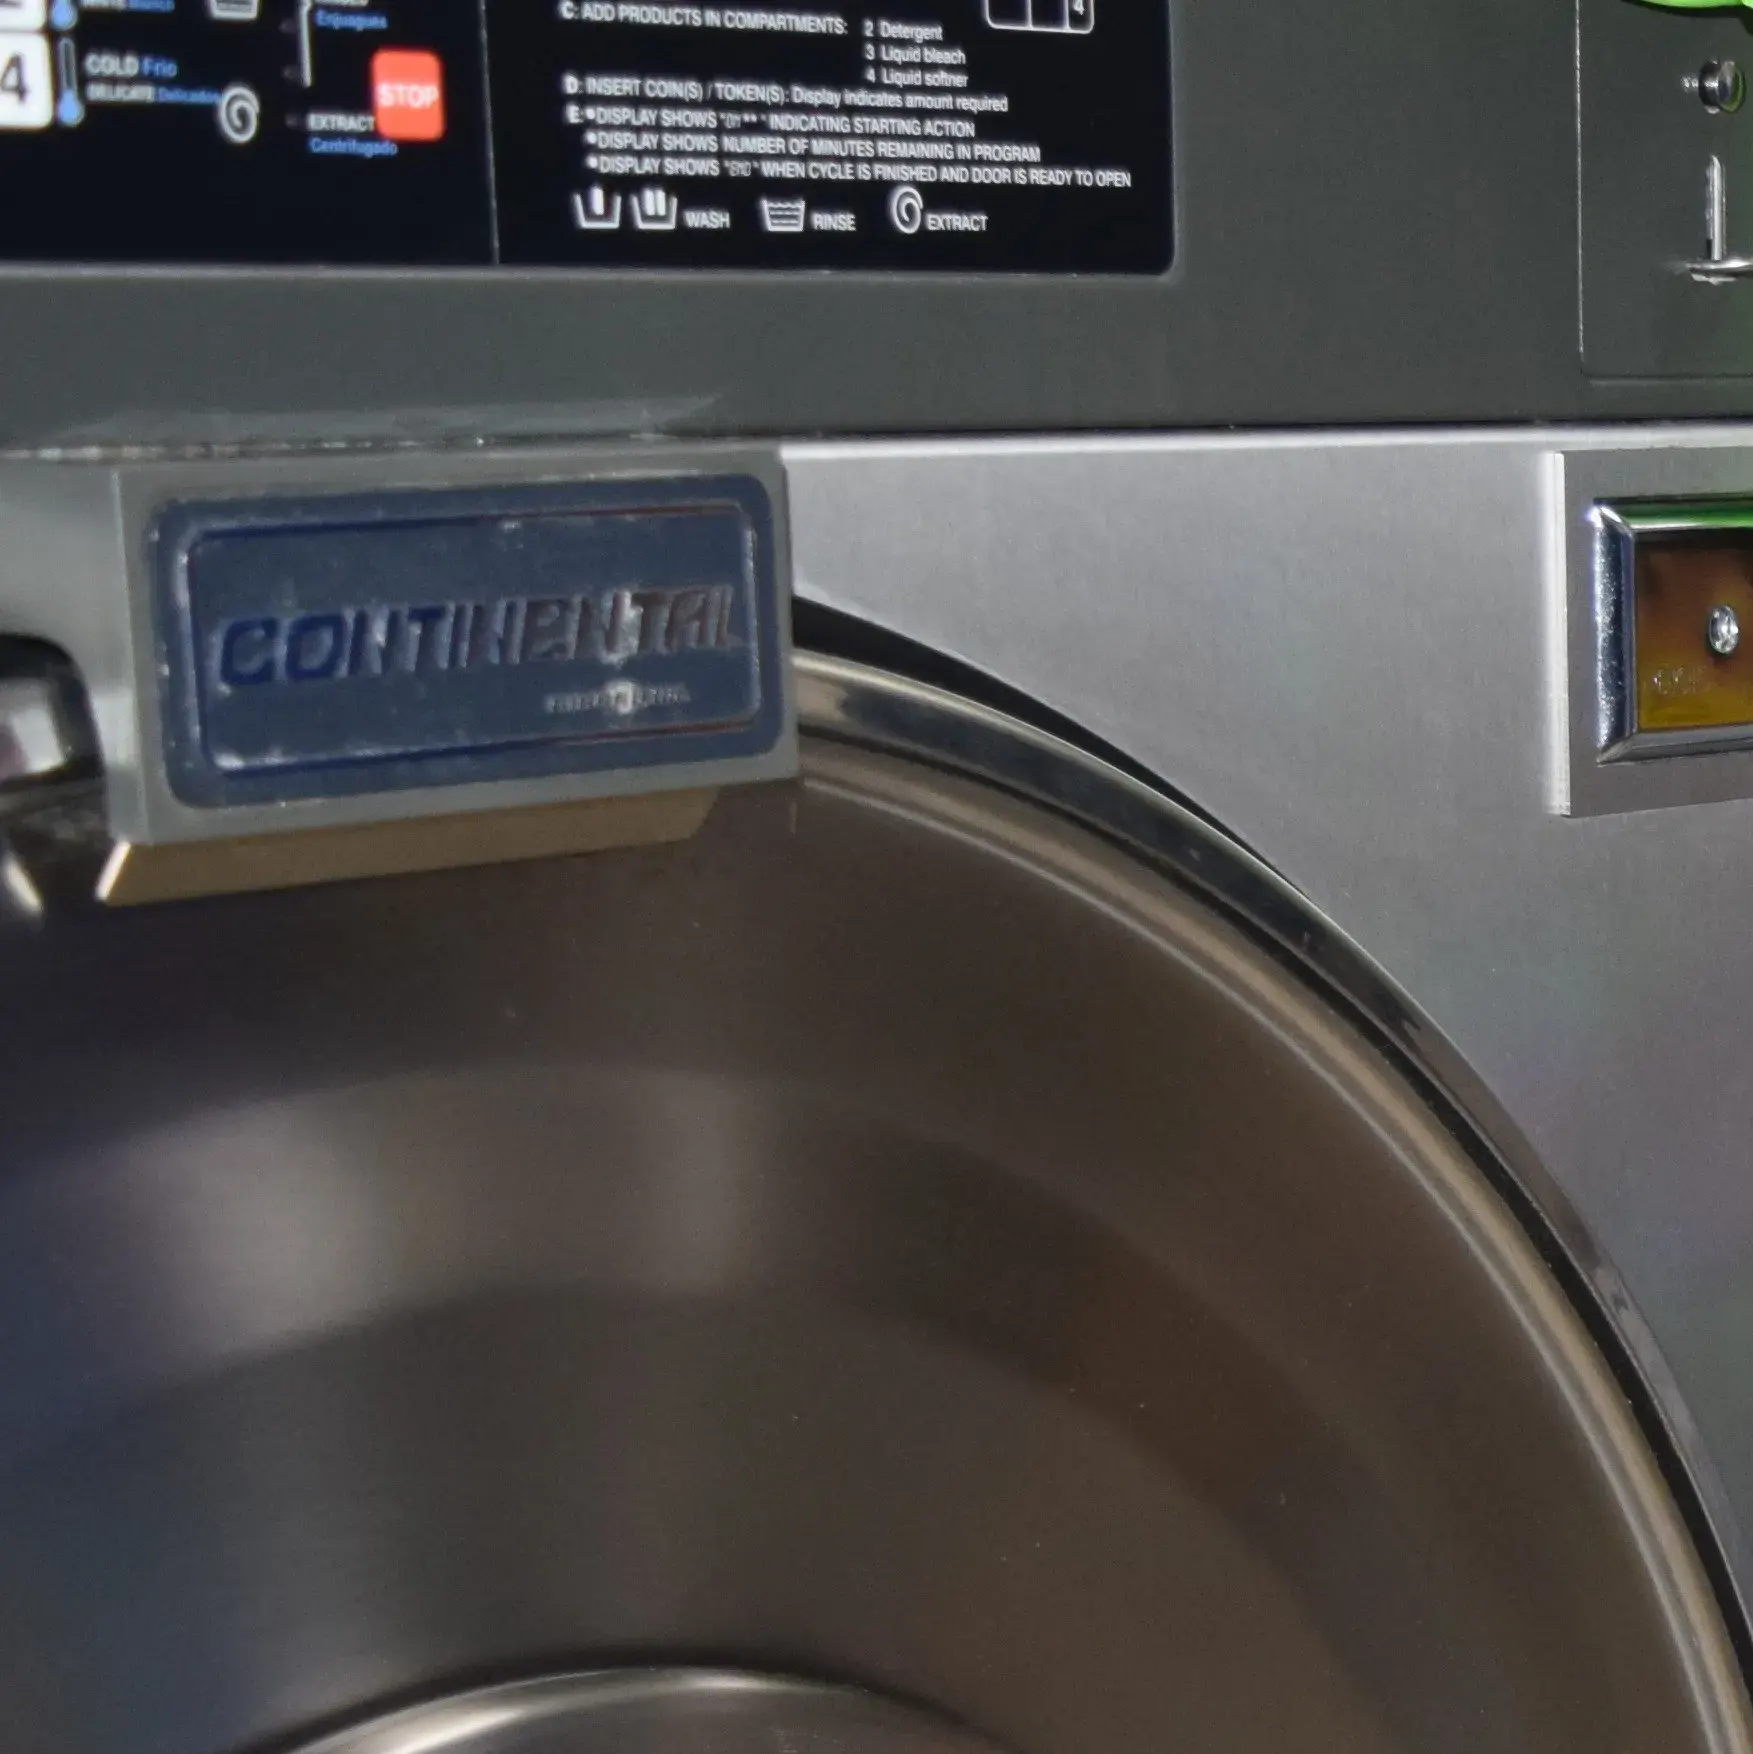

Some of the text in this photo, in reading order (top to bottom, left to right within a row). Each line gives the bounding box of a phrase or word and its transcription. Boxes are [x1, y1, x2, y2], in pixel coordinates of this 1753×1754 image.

[581, 3, 615, 22] ADD
[618, 5, 701, 27] PRODUCTS
[704, 11, 721, 28] IN
[724, 12, 848, 35] COMPARTMENTS:
[864, 20, 944, 43] 2 Detergent
[85, 51, 140, 77] COLD
[866, 43, 967, 65] 3 Liquid bleach
[1, 52, 28, 105] 4
[866, 67, 969, 88] 4 Liquid softner
[379, 83, 439, 108] STOP
[586, 75, 642, 97] INSERT
[644, 78, 703, 102] COIN(S)
[791, 86, 841, 108] Display
[845, 89, 903, 107] indicates
[905, 94, 954, 111] amount
[956, 96, 1009, 114] required
[308, 112, 375, 133] EXTRACT
[596, 107, 658, 127] DISPLAY
[661, 110, 718, 128] SHOWS
[769, 113, 851, 134] INDICATING
[854, 116, 921, 136] STARTING
[925, 119, 976, 138] ACTION
[598, 131, 1042, 163] DISPLAY SHOWS NUMBER OF MINUTES REMAINING IN PROGRAM
[600, 156, 662, 177] DISPLAY
[665, 158, 720, 178] SHOWS
[762, 161, 806, 179] WHEN
[808, 162, 854, 180] CYCLE
[858, 164, 872, 180] IS
[874, 164, 938, 183] FINISHED
[940, 166, 968, 184] AND
[971, 167, 1011, 185] DOOR
[1014, 168, 1028, 185] IS
[1030, 169, 1073, 187] READY
[1075, 170, 1094, 187] TO
[1096, 171, 1132, 188] OPEN
[685, 210, 731, 229] WASH
[811, 212, 857, 231] RINSE
[926, 214, 989, 232] EXTRACT
